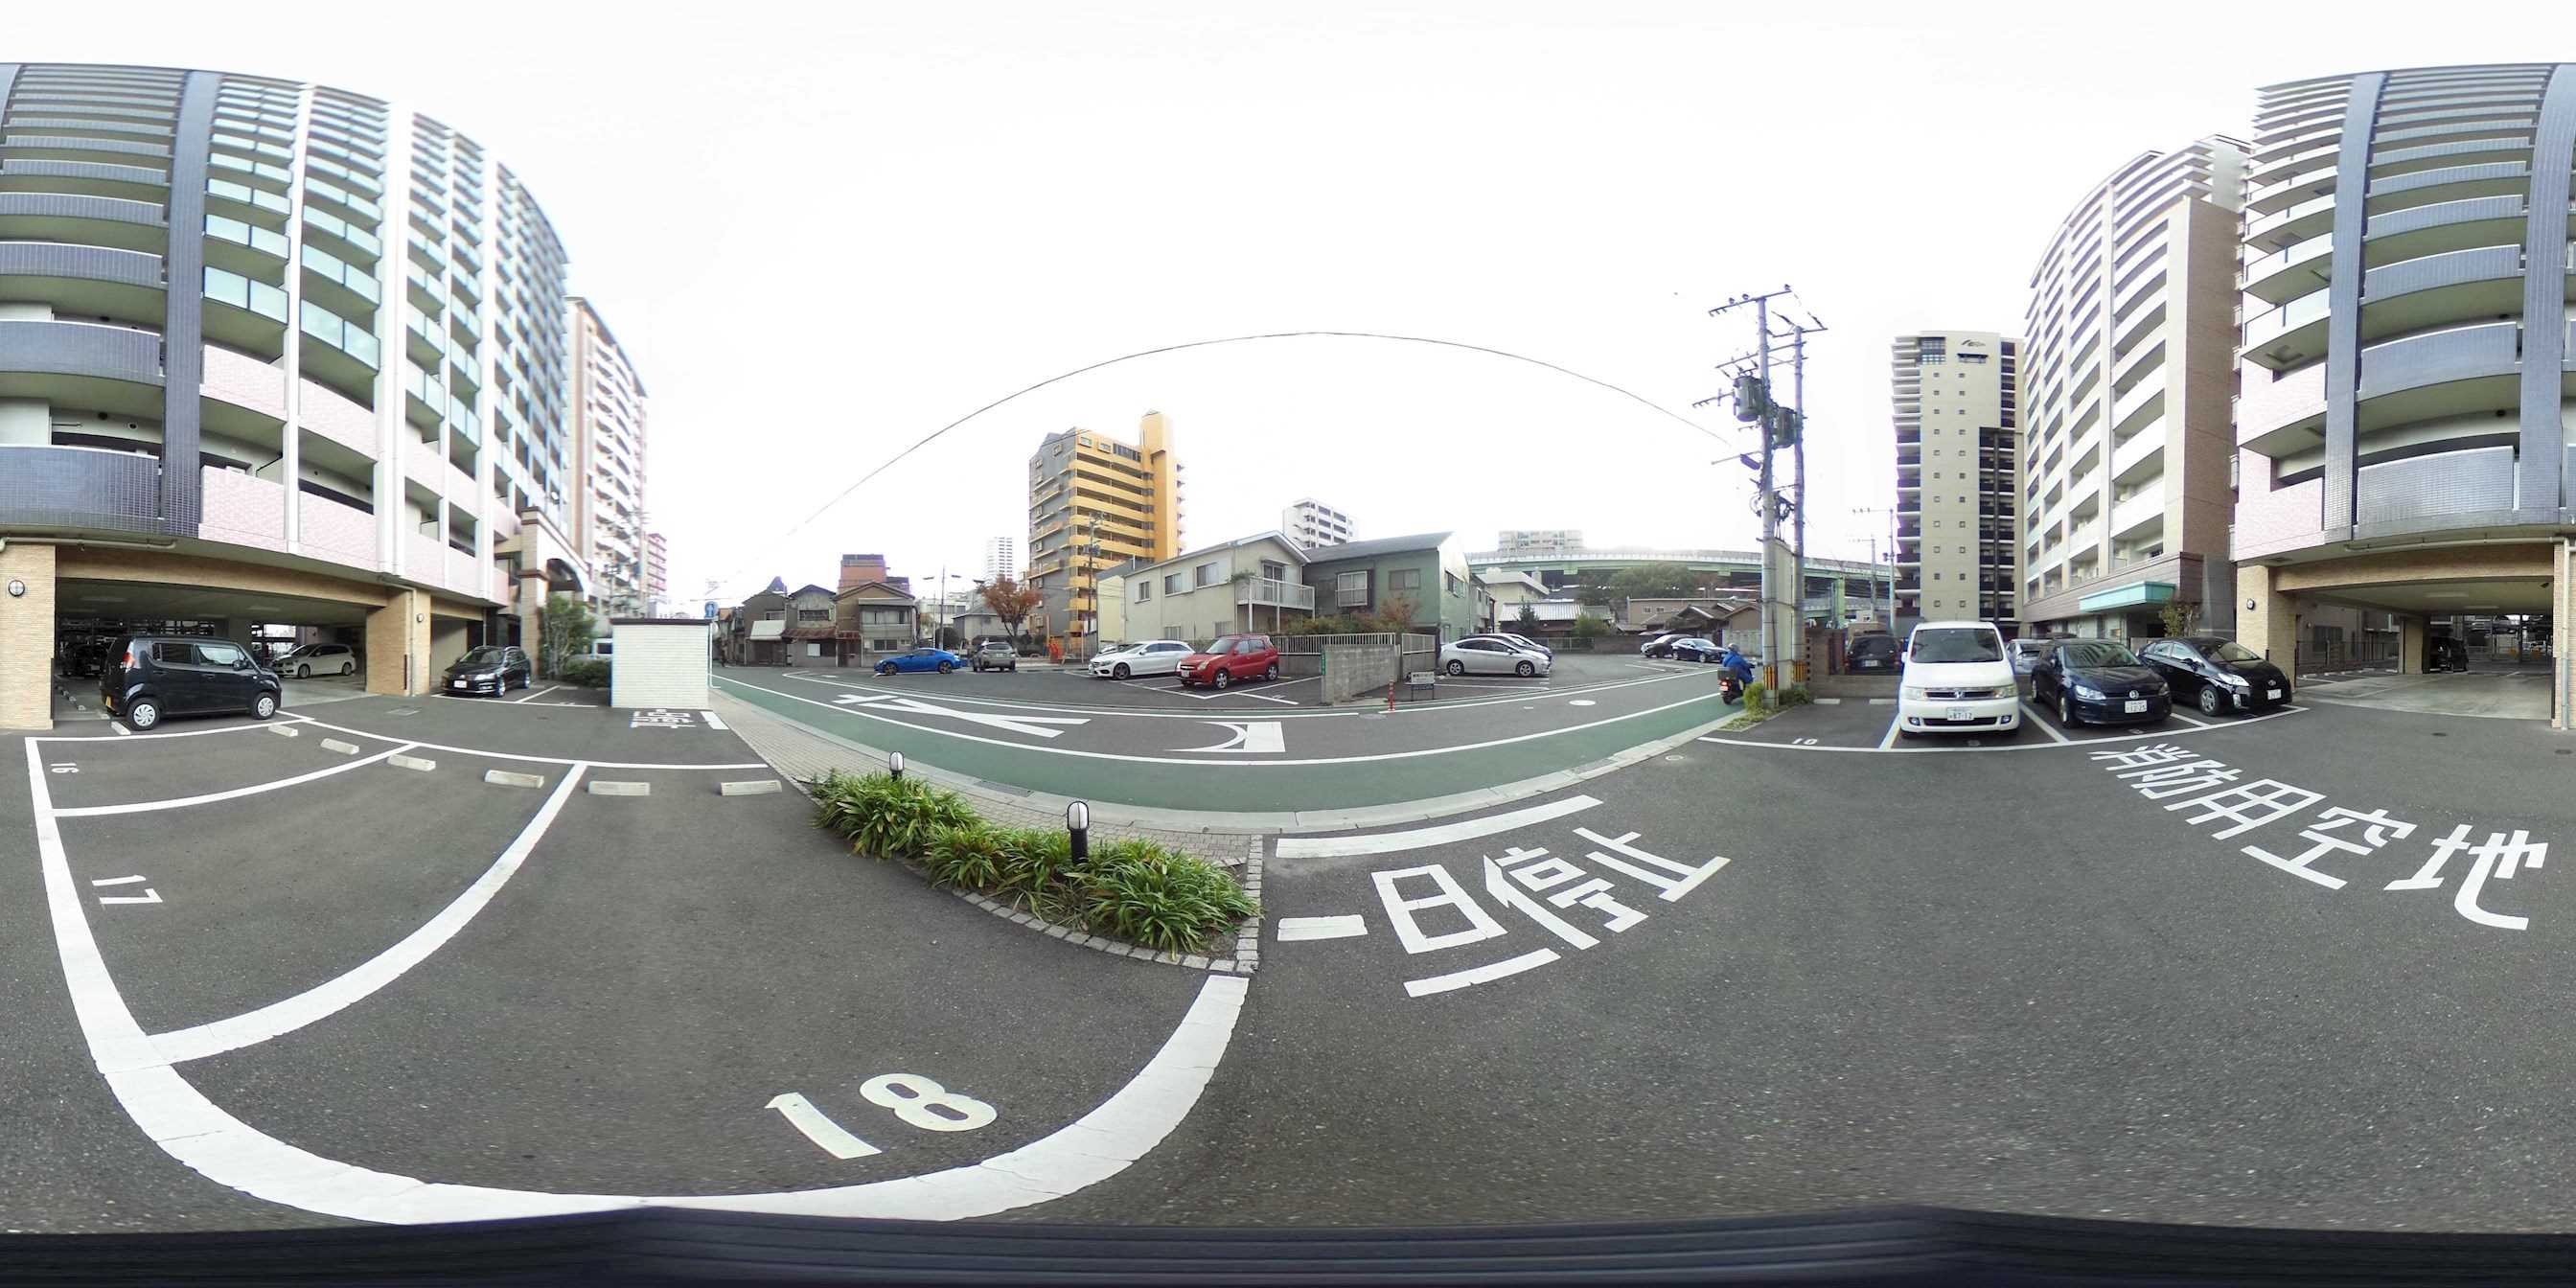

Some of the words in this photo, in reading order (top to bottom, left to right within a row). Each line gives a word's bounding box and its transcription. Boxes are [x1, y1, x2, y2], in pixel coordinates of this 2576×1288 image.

[50, 763, 80, 773] 16
[2087, 743, 2549, 931] 消防用空地
[91, 874, 164, 905] 17
[1276, 827, 1732, 998] 一旦停止
[764, 1072, 999, 1160] 18
